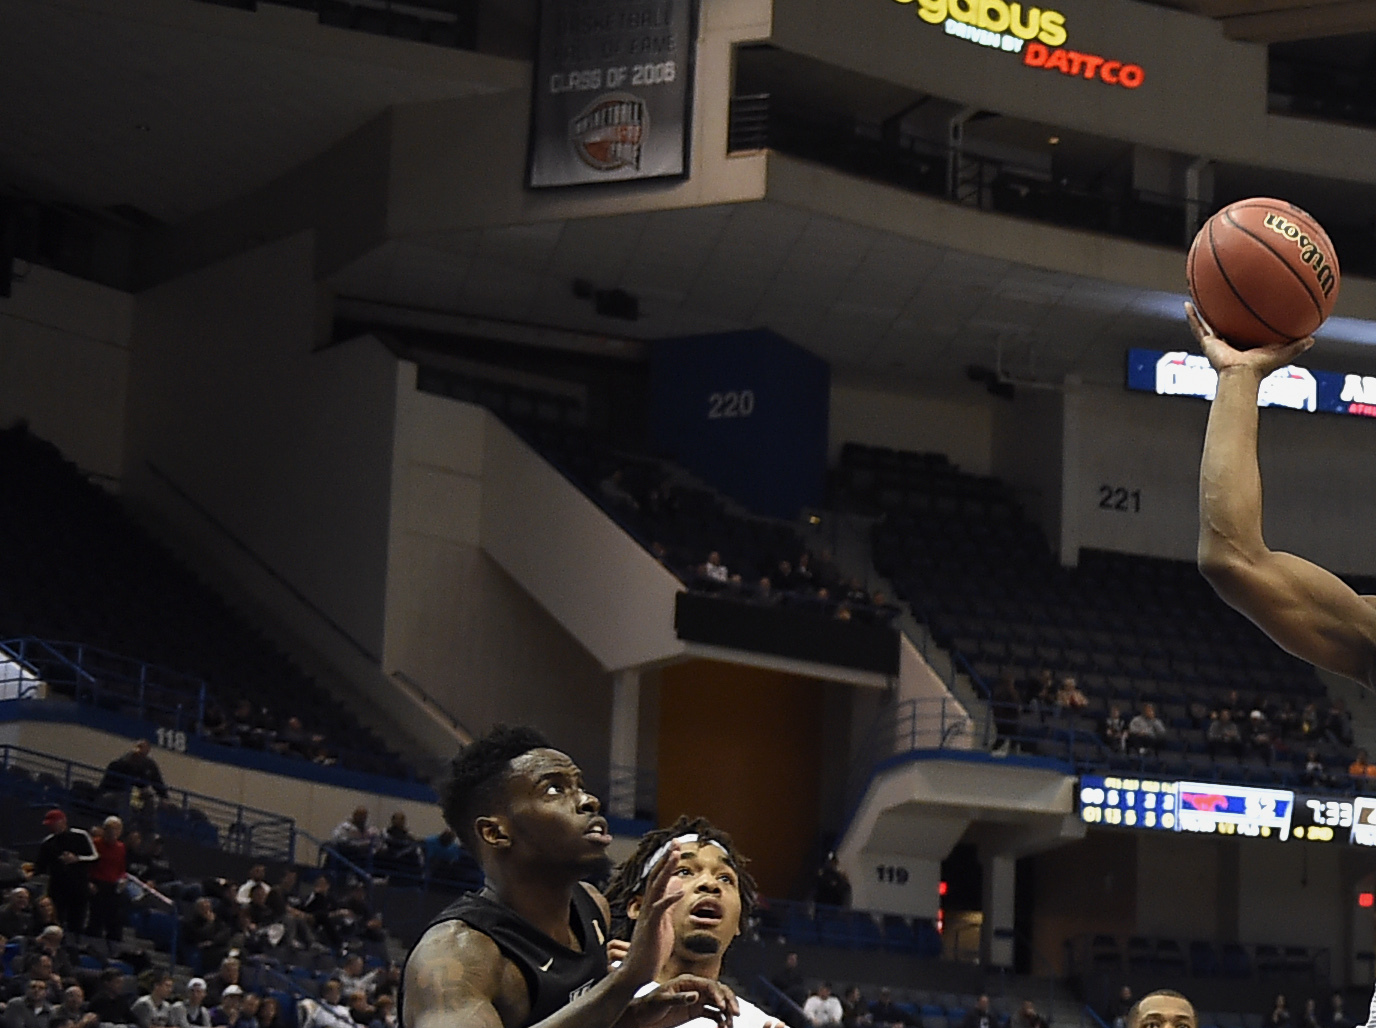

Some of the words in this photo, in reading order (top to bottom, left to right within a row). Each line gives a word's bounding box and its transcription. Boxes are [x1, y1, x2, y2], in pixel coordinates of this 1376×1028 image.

[1024, 41, 1144, 88] DATTCO
[550, 68, 602, 93] CLASS
[606, 66, 628, 88] OF
[708, 389, 755, 419] 220
[1100, 485, 1141, 513] 221
[156, 727, 188, 752] 118
[1306, 799, 1353, 827] 7:33
